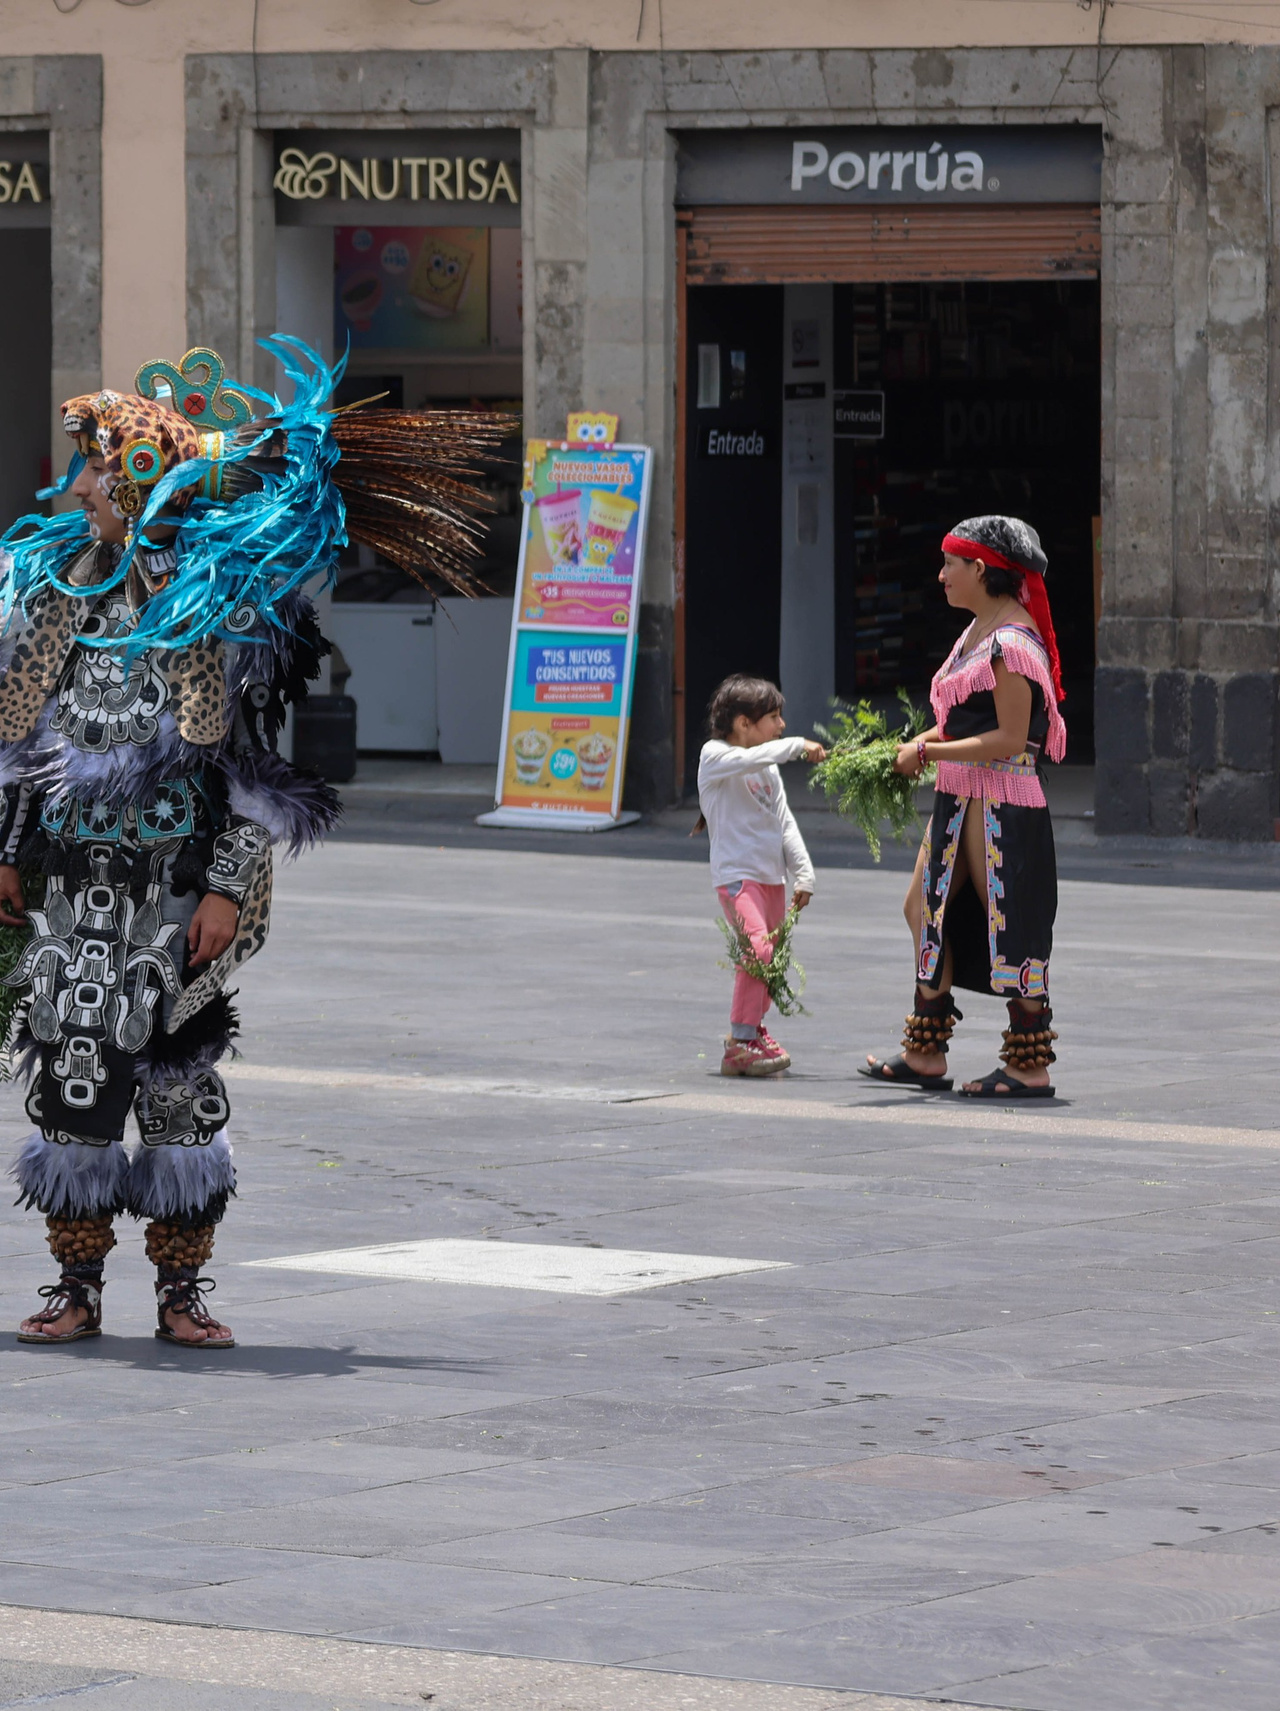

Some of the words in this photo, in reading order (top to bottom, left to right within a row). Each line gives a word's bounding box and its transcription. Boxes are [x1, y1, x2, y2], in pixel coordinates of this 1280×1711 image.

[340, 157, 519, 204] NUTRISA
[835, 407, 881, 423] Entrada
[708, 430, 764, 457] Entrada
[553, 461, 593, 472] NUEVOS
[596, 462, 629, 473] VASOS
[548, 471, 633, 483] COLECCIONABLES
[542, 650, 565, 665] TUS
[569, 649, 611, 665] NUEVOS
[536, 664, 616, 681] CONSENTIDOS
